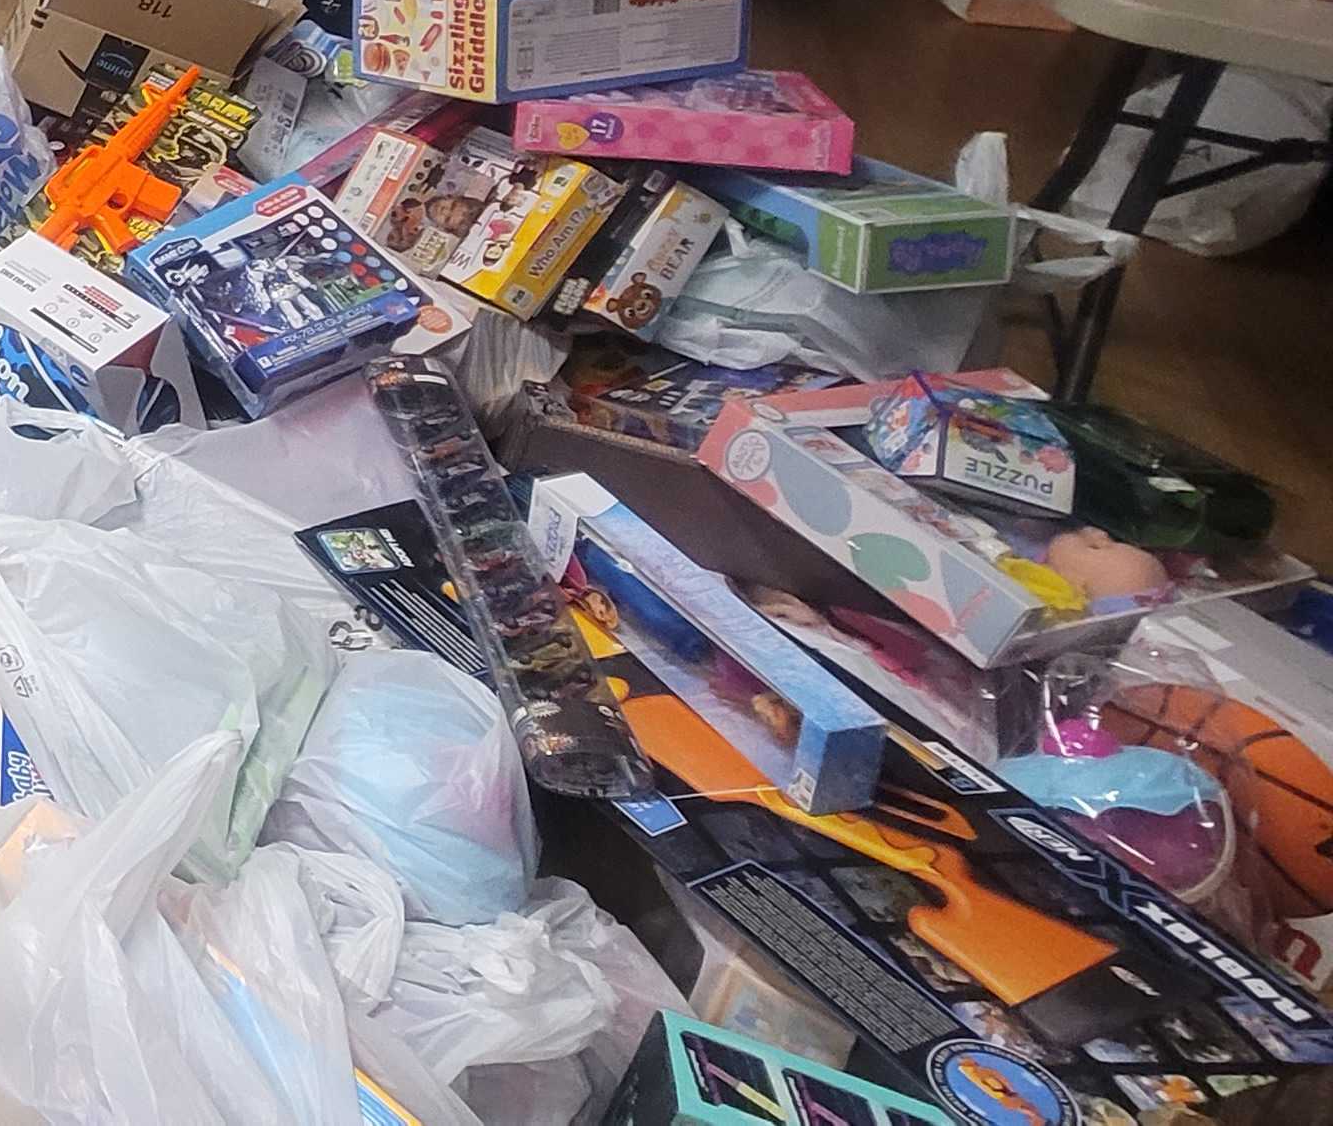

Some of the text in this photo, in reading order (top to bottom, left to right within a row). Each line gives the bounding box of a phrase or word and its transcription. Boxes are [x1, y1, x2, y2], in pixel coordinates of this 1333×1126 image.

[96, 57, 134, 80] prime
[193, 90, 253, 125] ARMY
[528, 209, 584, 279] Who Am I?
[660, 237, 695, 282] BEAR
[964, 456, 1054, 494] PUZZLE
[1007, 816, 1094, 862] NERF
[1135, 900, 1314, 1023] ROBLOX
